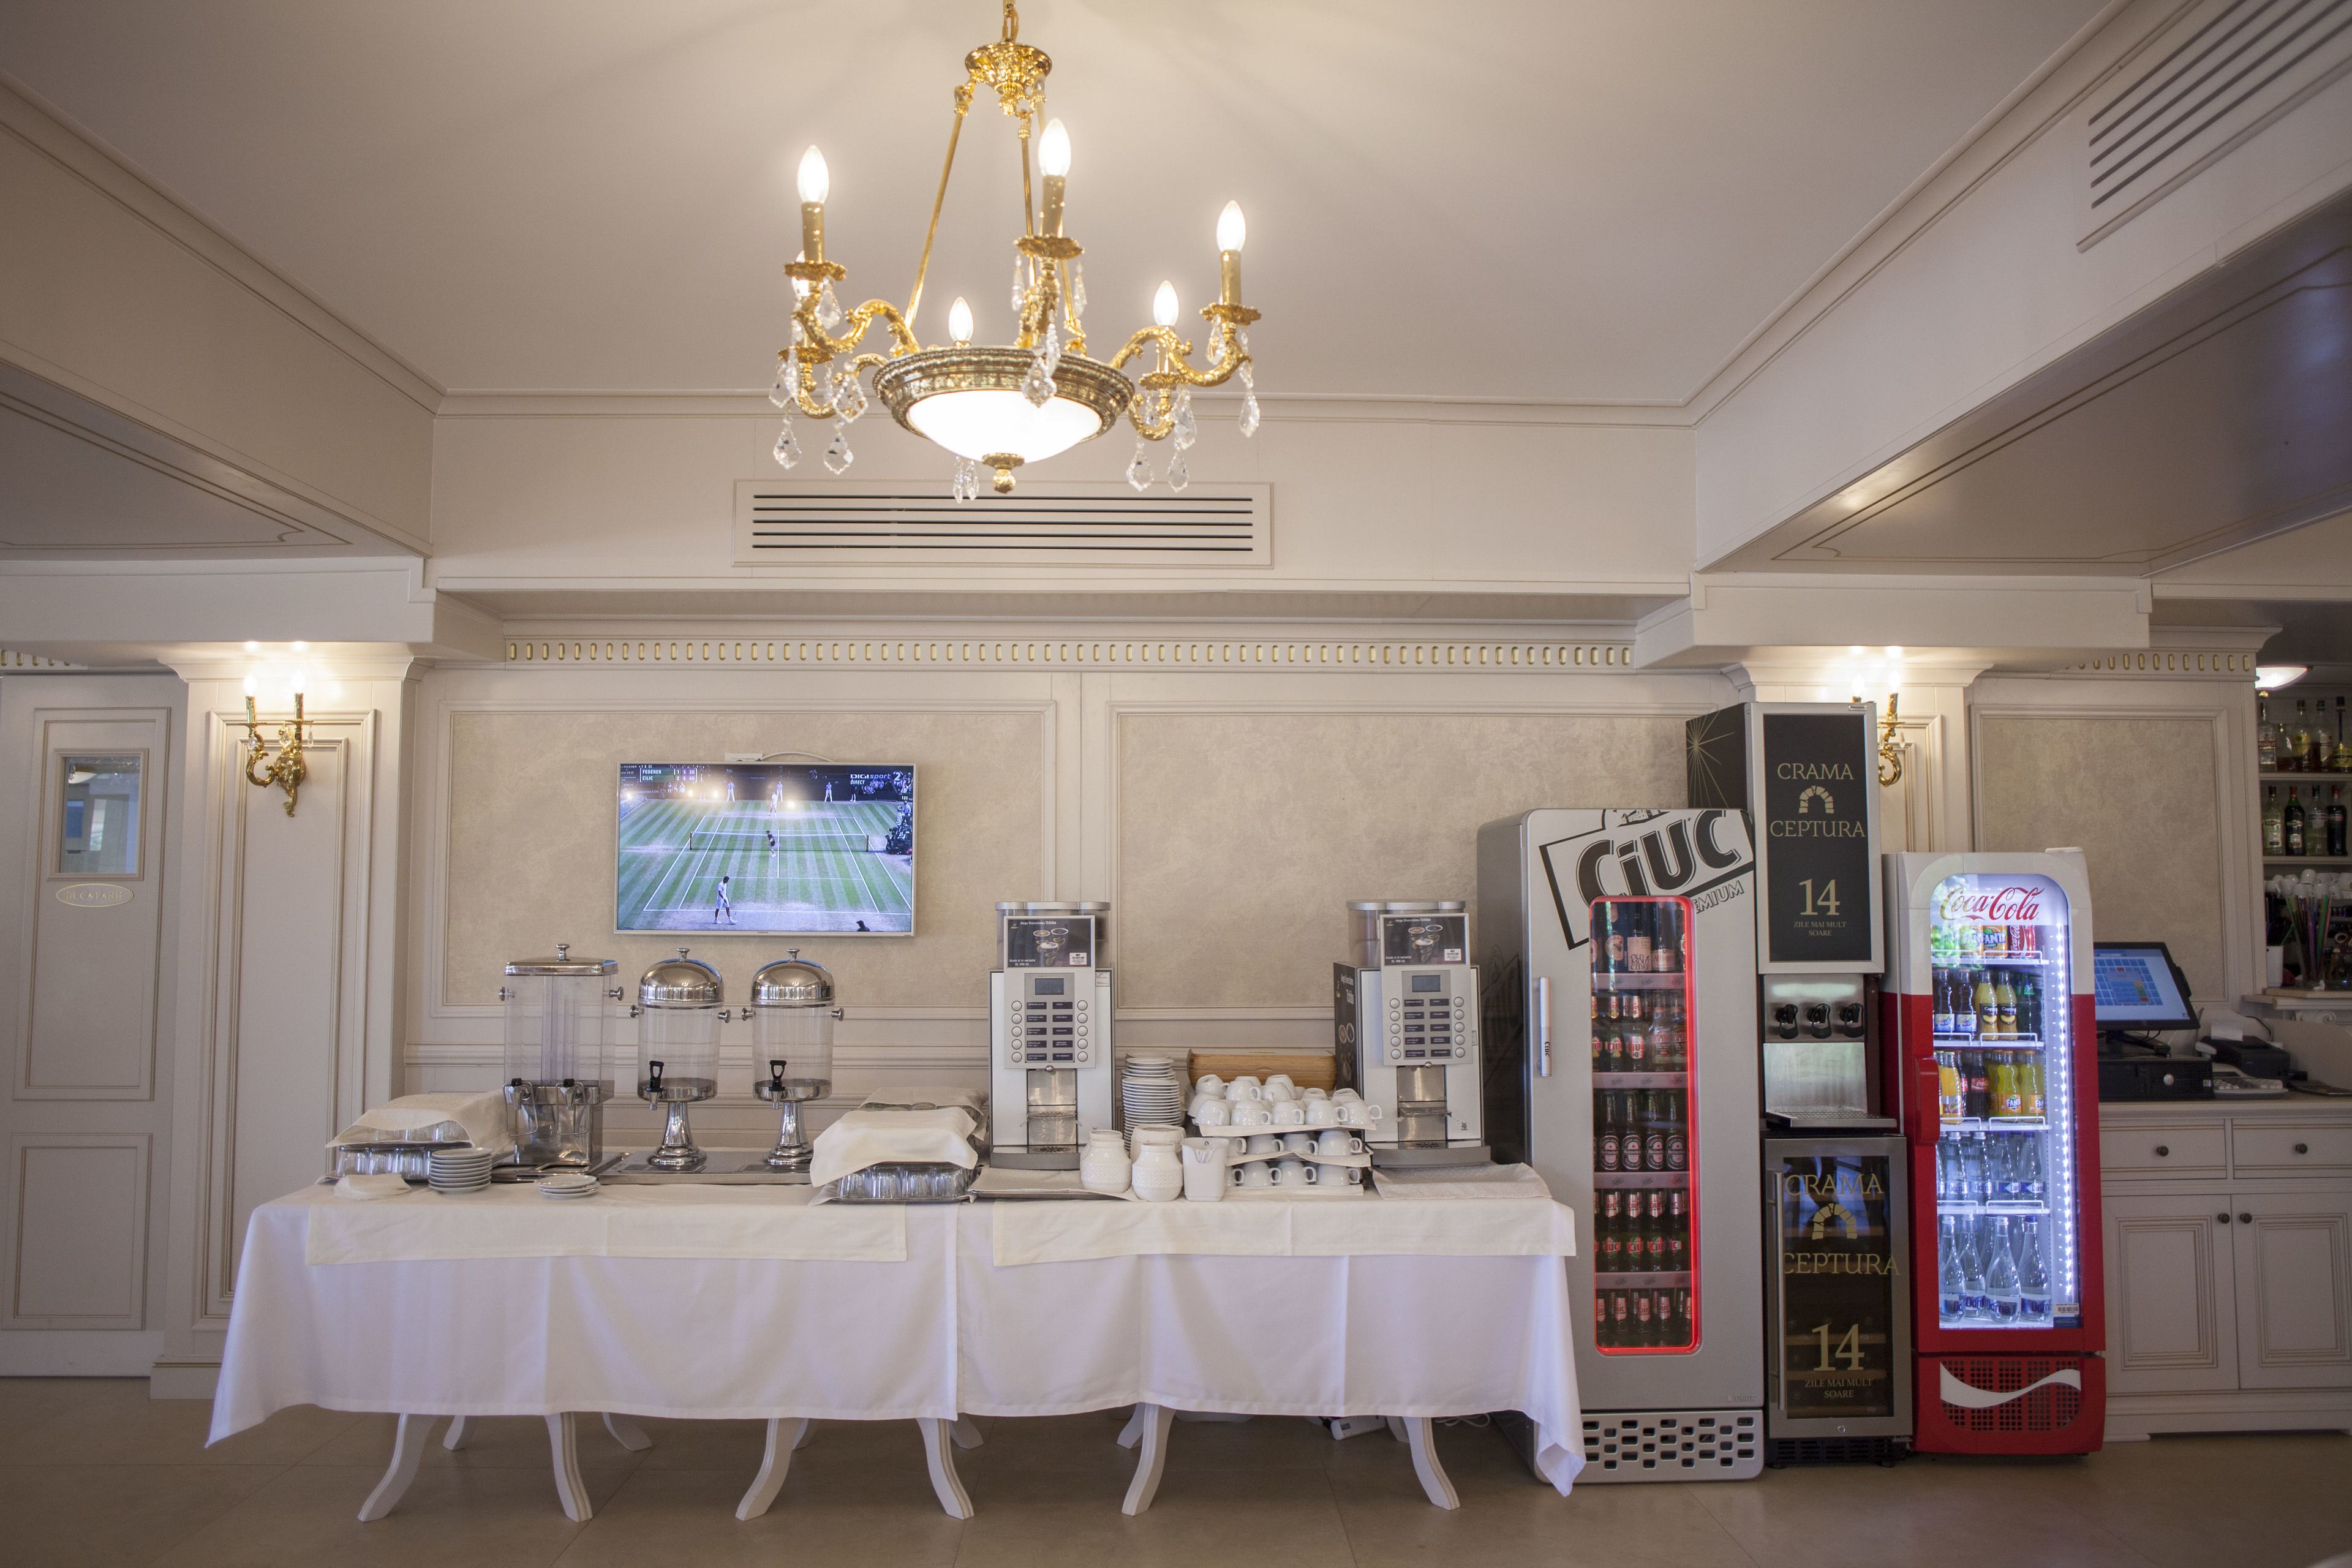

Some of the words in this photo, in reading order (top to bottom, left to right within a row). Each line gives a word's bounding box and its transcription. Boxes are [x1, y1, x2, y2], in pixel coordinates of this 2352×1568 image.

[1777, 763, 1854, 780] CRAMA
[1770, 820, 1866, 837] CEPTURA
[1694, 880, 1745, 914] EMIUM
[1800, 879, 1841, 915] 14
[1940, 887, 2045, 921] Coca-Cola
[1785, 1173, 1884, 1195] CRAMA
[1784, 1253, 1901, 1275] CEPTURA
[1812, 1323, 1865, 1371] 14
[1827, 1379, 1845, 1387] MAI
[1847, 1378, 1874, 1387] MULT
[1824, 1390, 1854, 1398] SOARE
